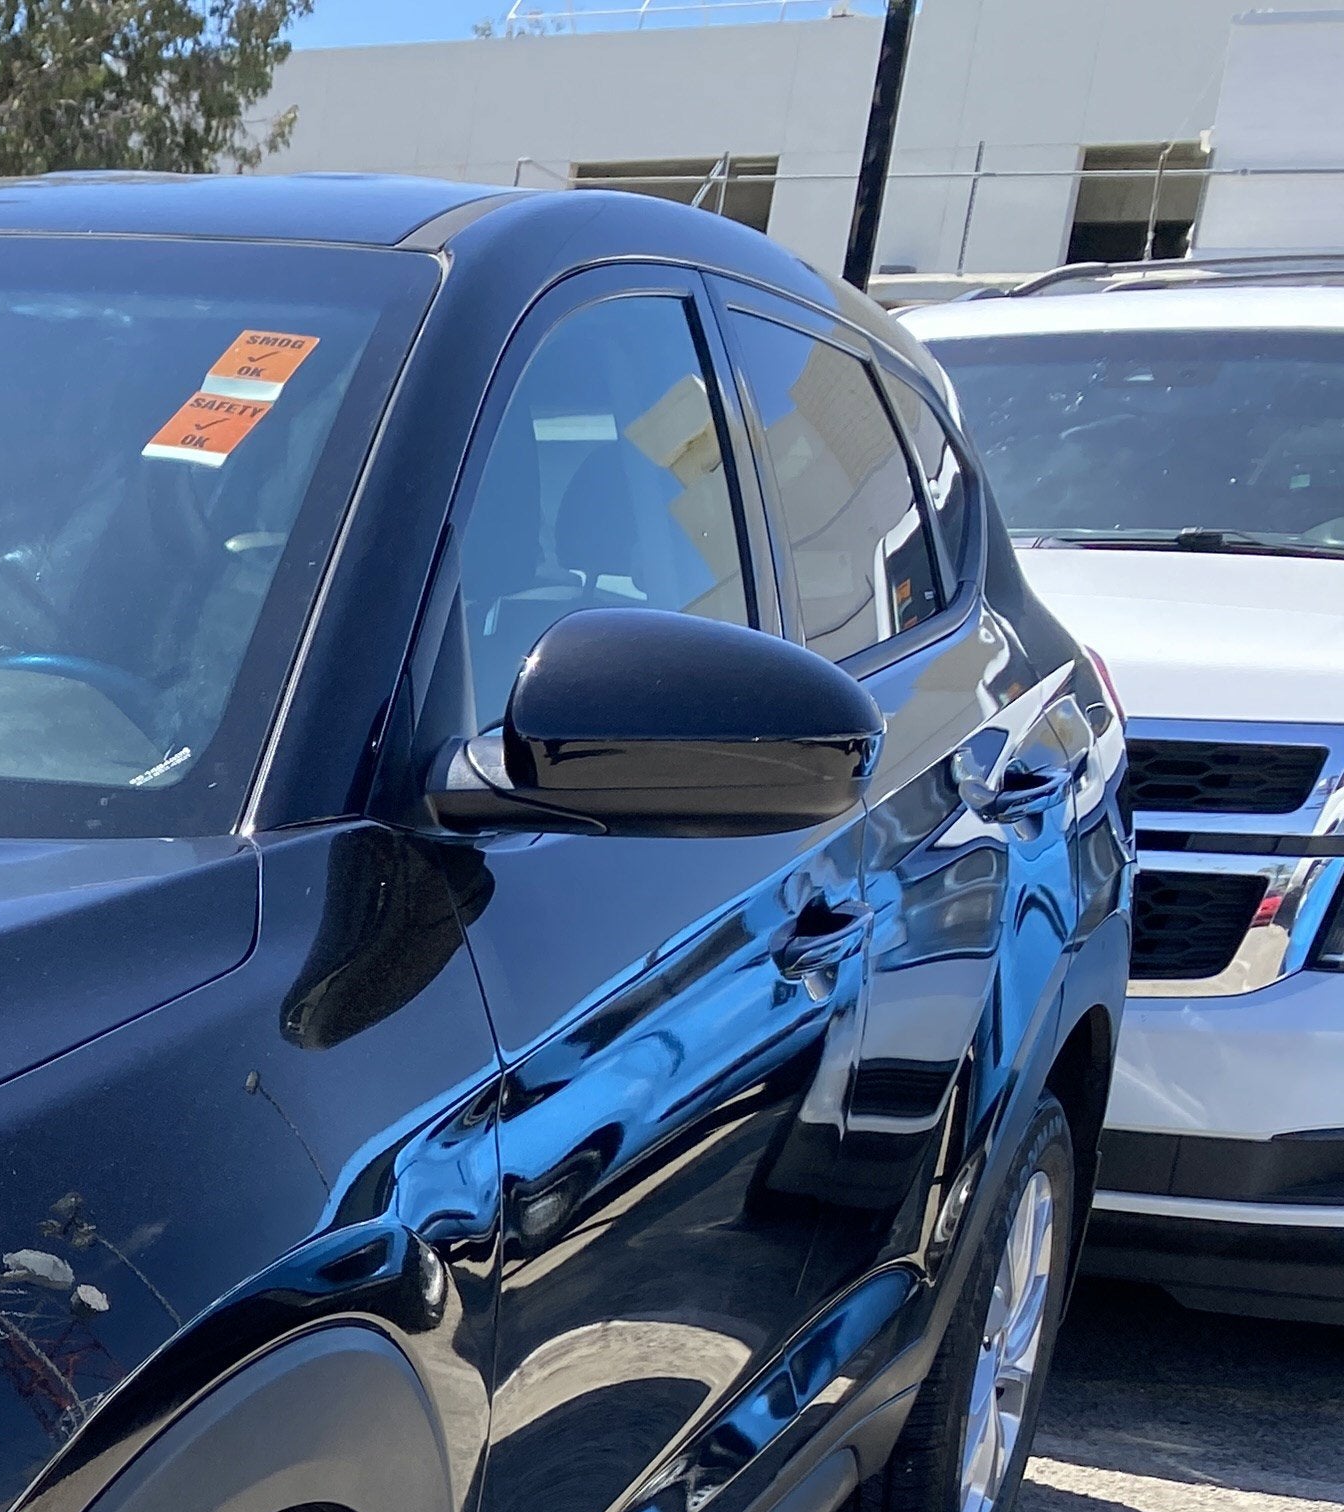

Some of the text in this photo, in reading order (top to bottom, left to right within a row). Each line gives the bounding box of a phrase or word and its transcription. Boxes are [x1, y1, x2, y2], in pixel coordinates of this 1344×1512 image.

[245, 335, 306, 350] SMOG
[237, 366, 267, 378] OK
[189, 397, 264, 418] SAFETY
[180, 434, 210, 448] OK
